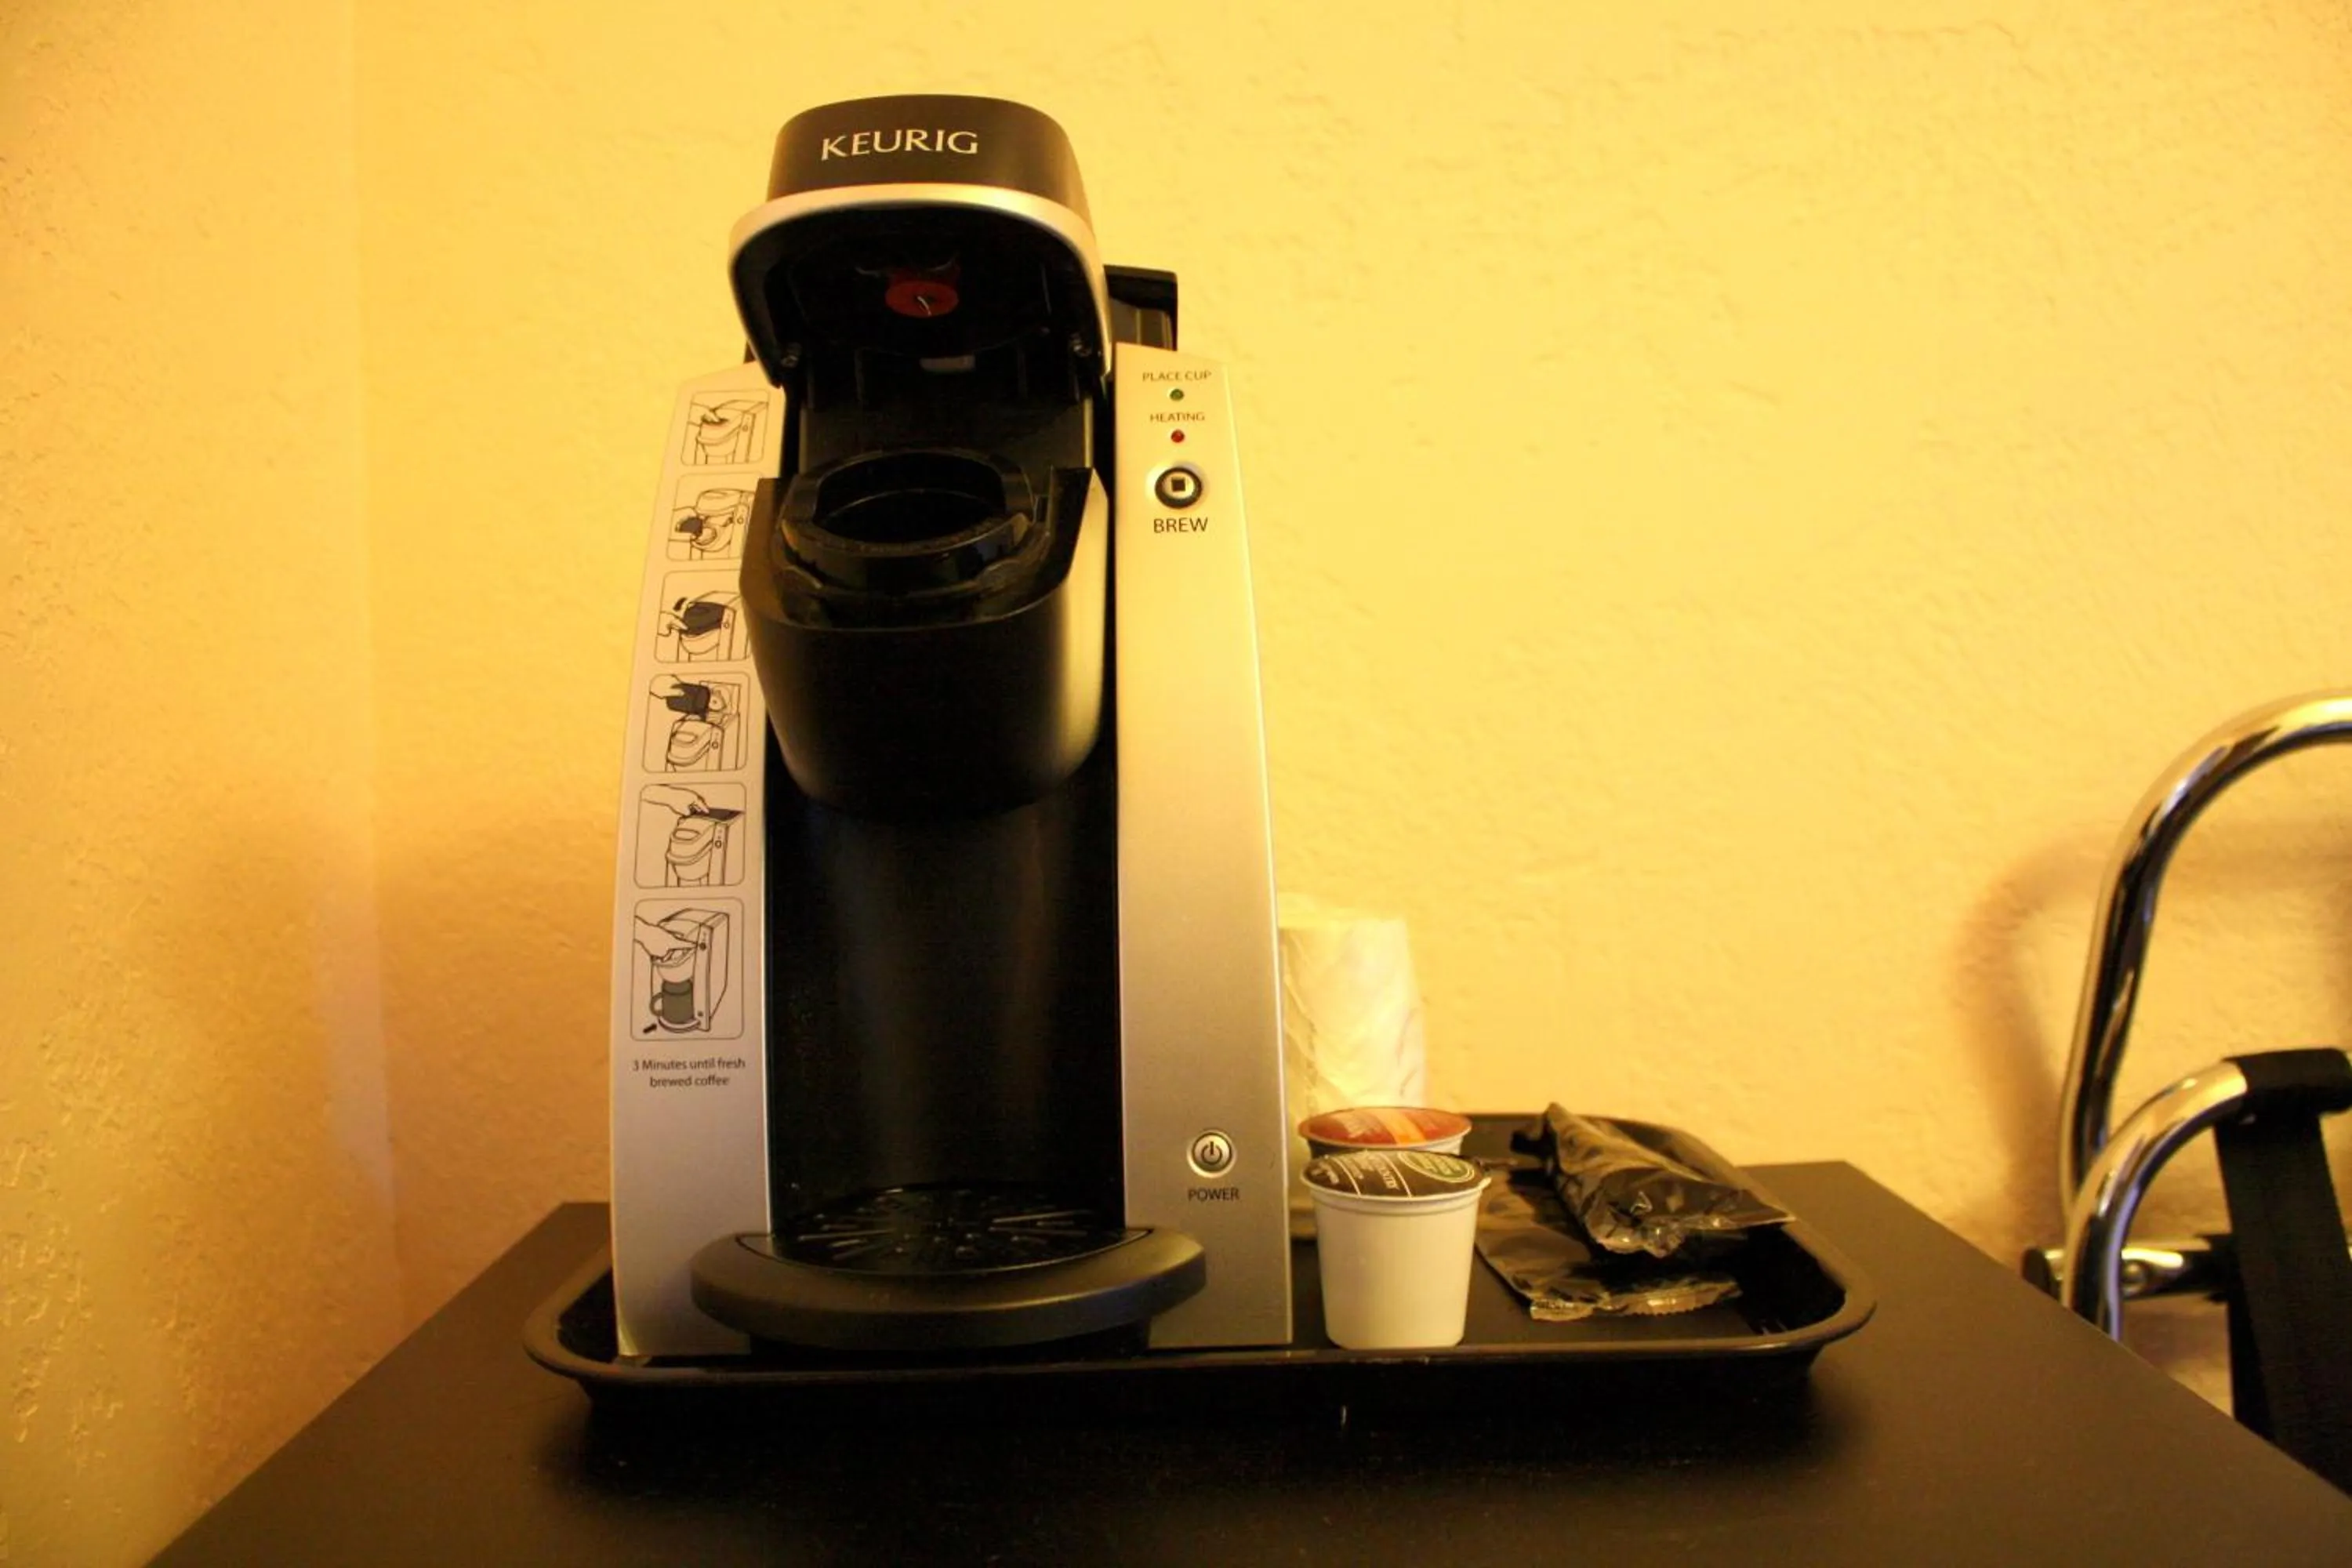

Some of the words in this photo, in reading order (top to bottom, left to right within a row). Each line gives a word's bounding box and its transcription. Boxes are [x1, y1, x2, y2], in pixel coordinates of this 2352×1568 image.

[821, 129, 978, 161] KEURIG
[1142, 372, 1182, 382] PLACE
[1185, 371, 1212, 380] CUP
[1149, 412, 1206, 423] HEATING
[1153, 517, 1208, 533] BREW
[633, 1059, 639, 1071] 3
[642, 1059, 687, 1071] Minutes
[689, 1058, 715, 1070] until
[717, 1057, 746, 1069] fresh
[650, 1076, 692, 1087] brewed
[695, 1073, 730, 1087] coffee
[1188, 1187, 1240, 1201] POWER
